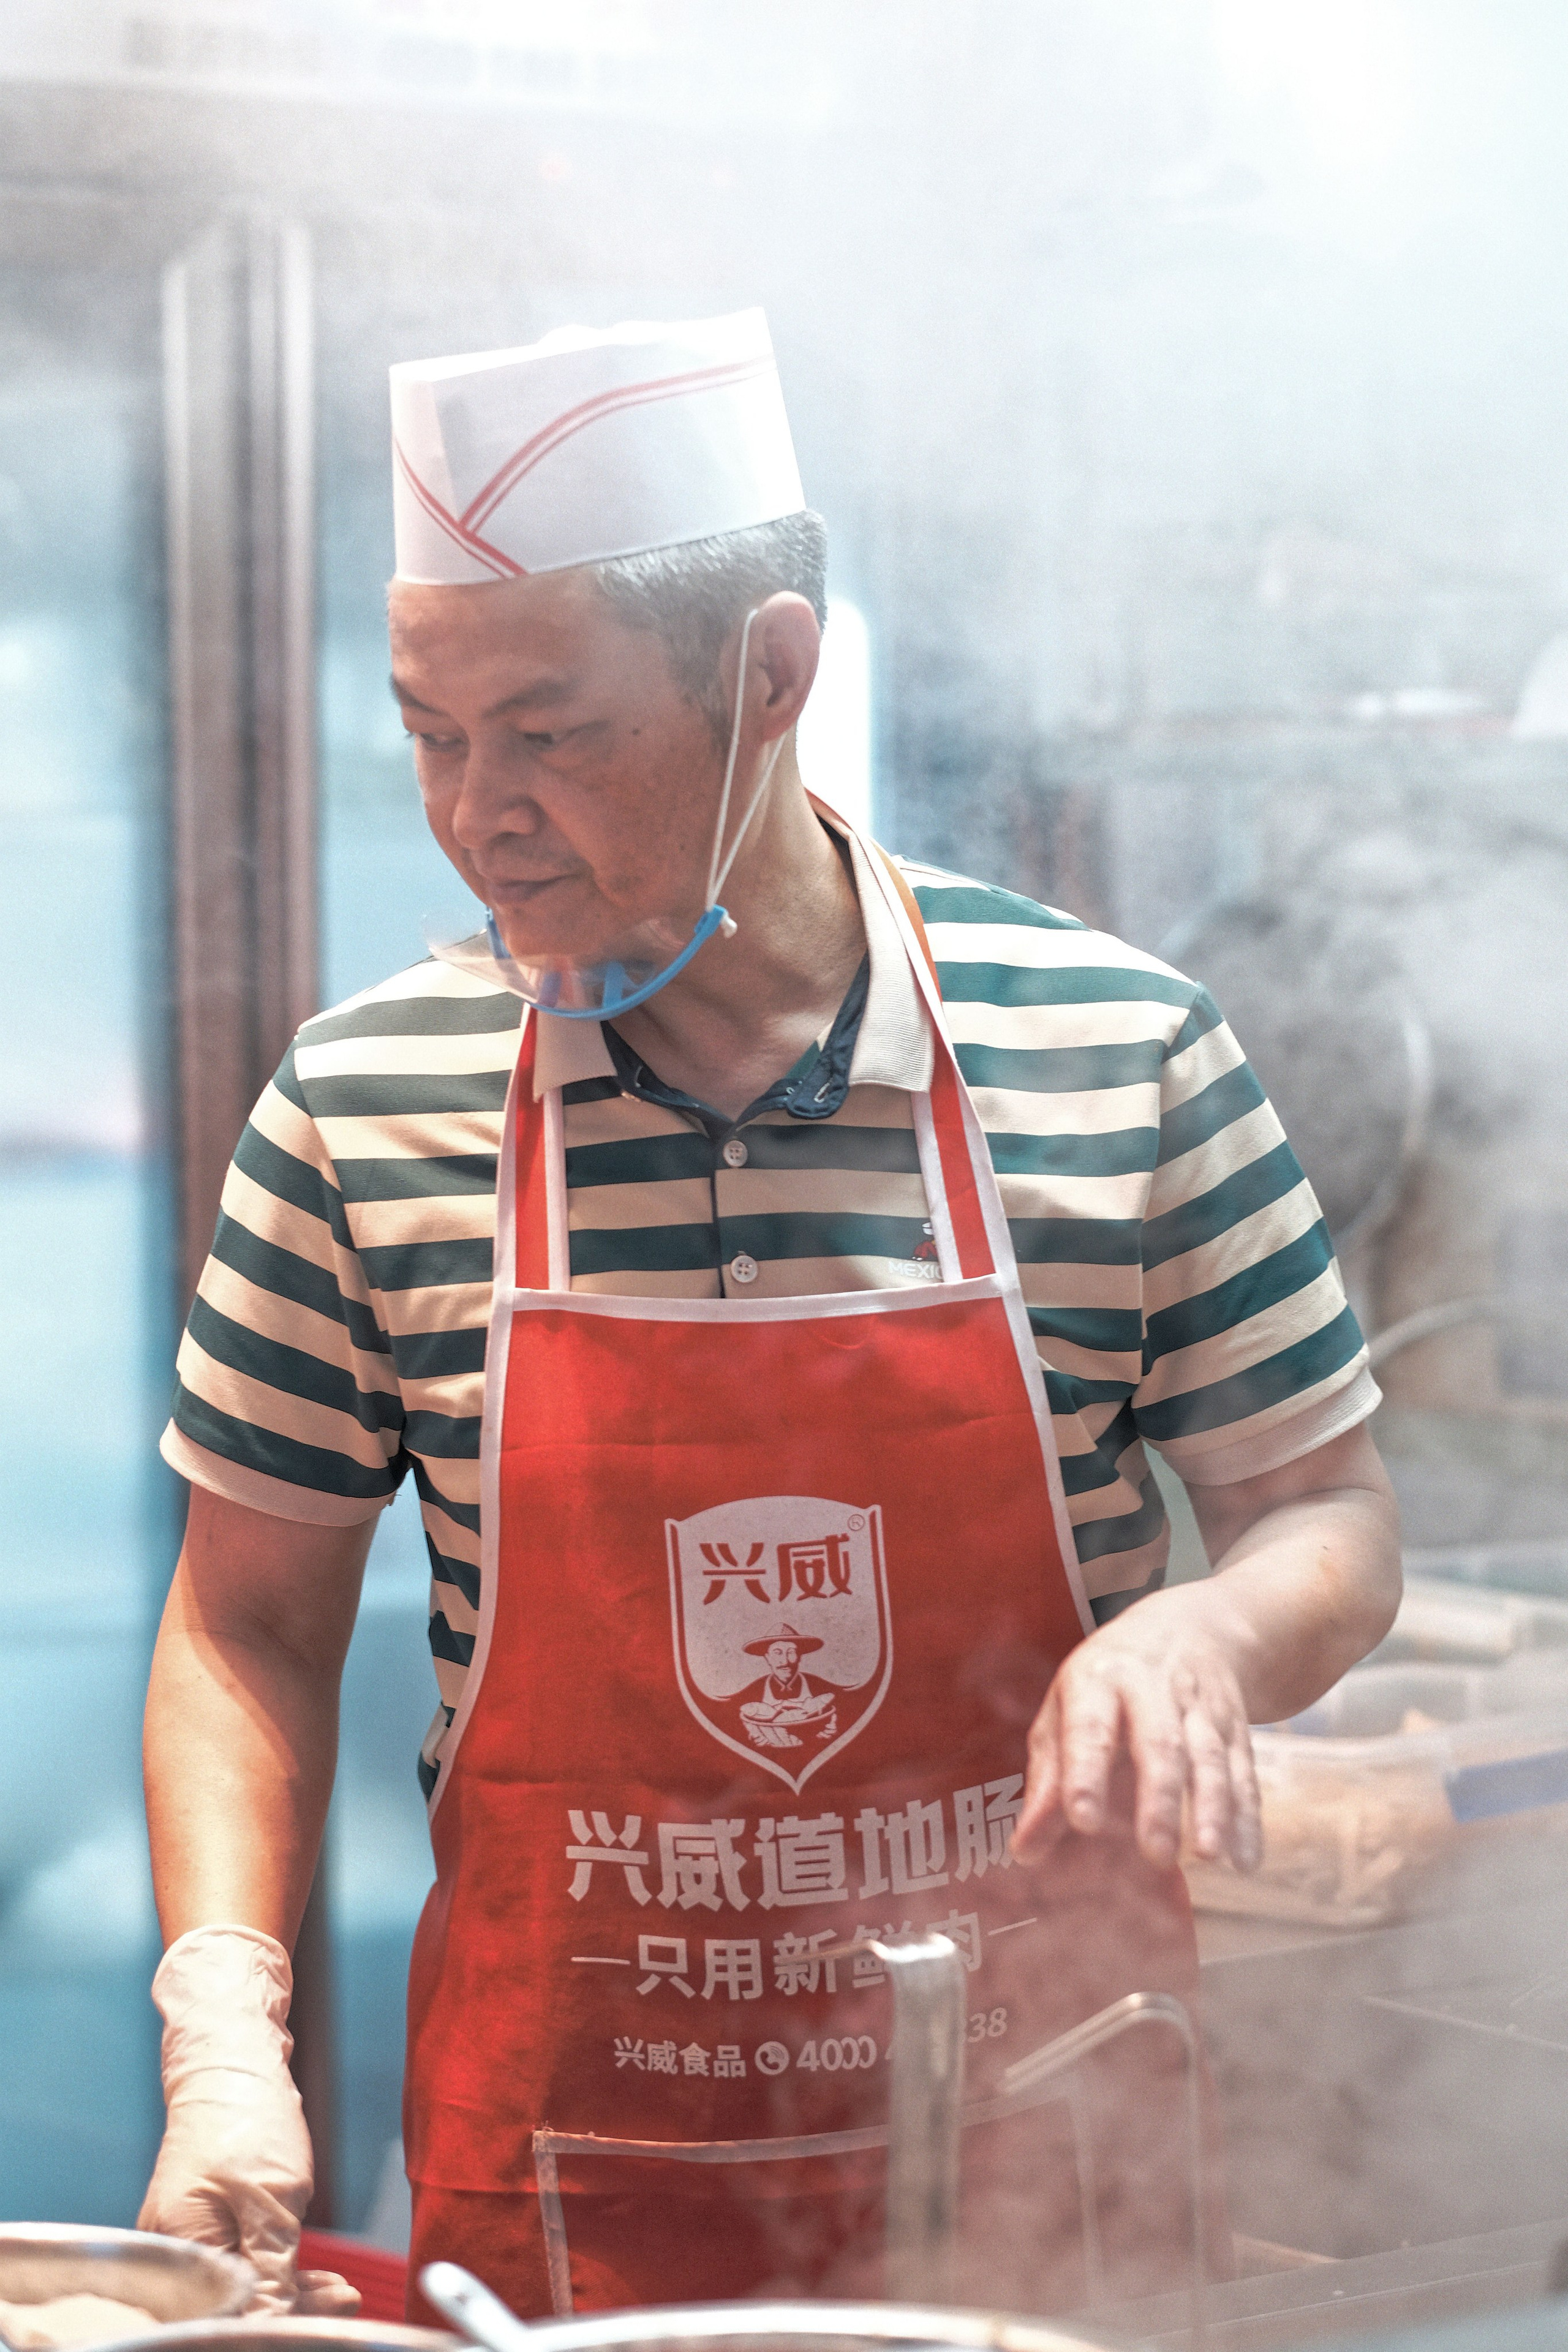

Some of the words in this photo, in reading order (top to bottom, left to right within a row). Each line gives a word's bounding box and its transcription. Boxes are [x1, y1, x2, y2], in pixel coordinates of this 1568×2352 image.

[699, 1532, 853, 1605] 兴威
[566, 1773, 1025, 1912] 兴威道地肠
[613, 2036, 747, 2078] 兴威食品
